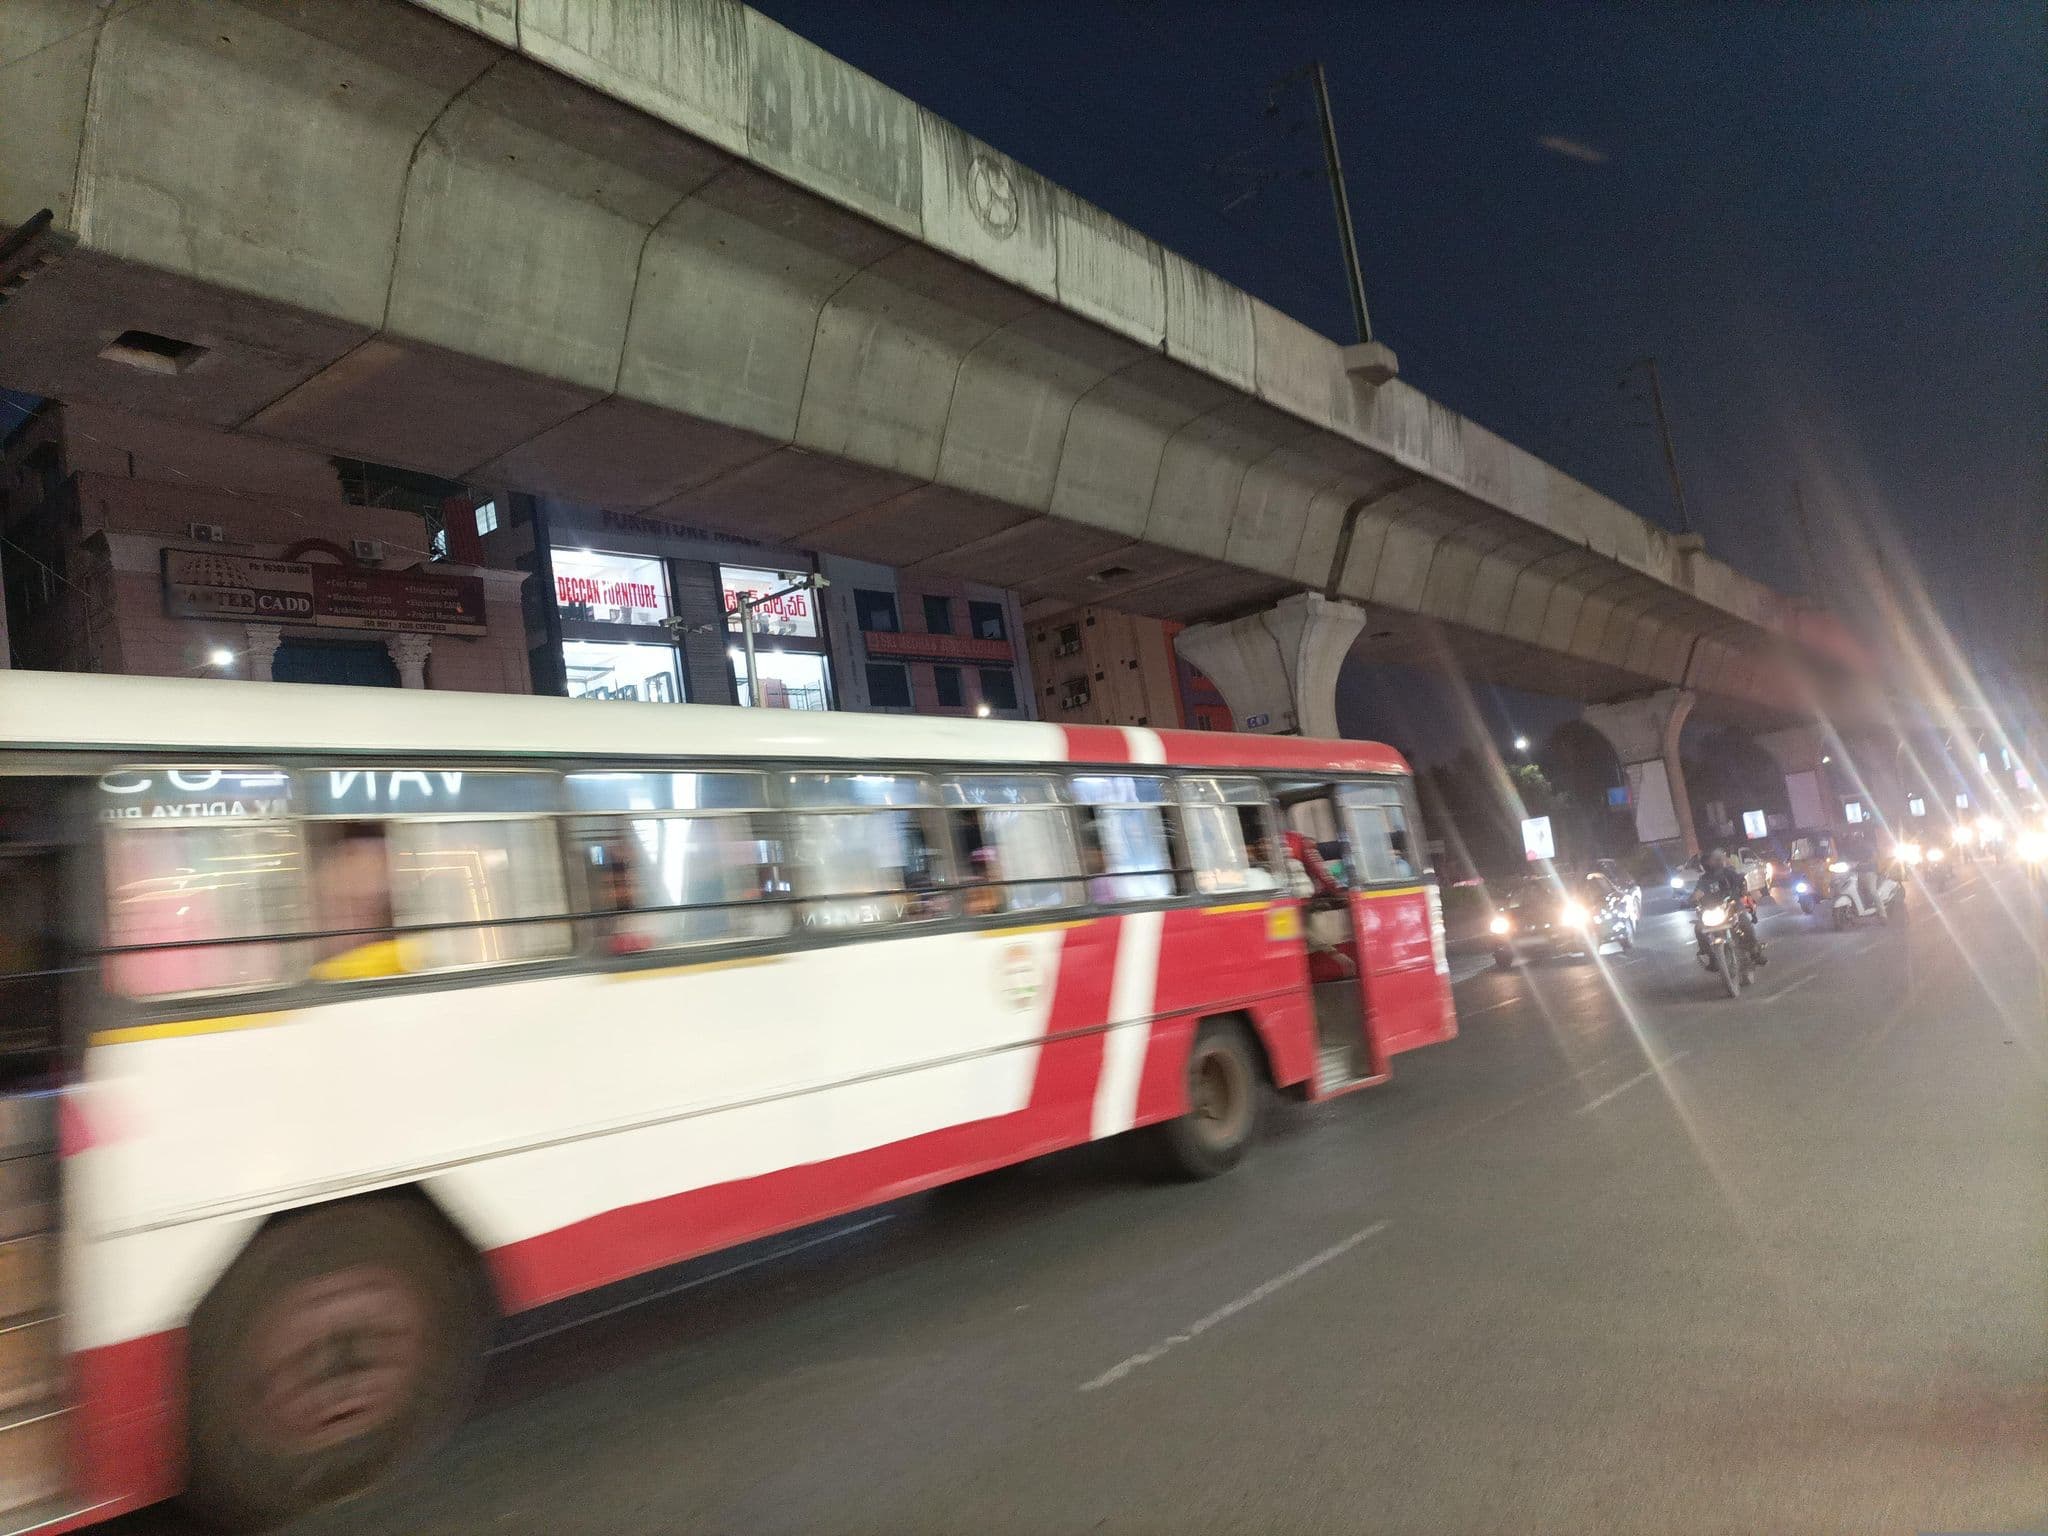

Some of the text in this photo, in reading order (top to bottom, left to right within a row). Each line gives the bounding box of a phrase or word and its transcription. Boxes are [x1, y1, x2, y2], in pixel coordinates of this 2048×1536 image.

[259, 595, 310, 611] CADD
[557, 577, 658, 609] DECCAN FURNITURE
